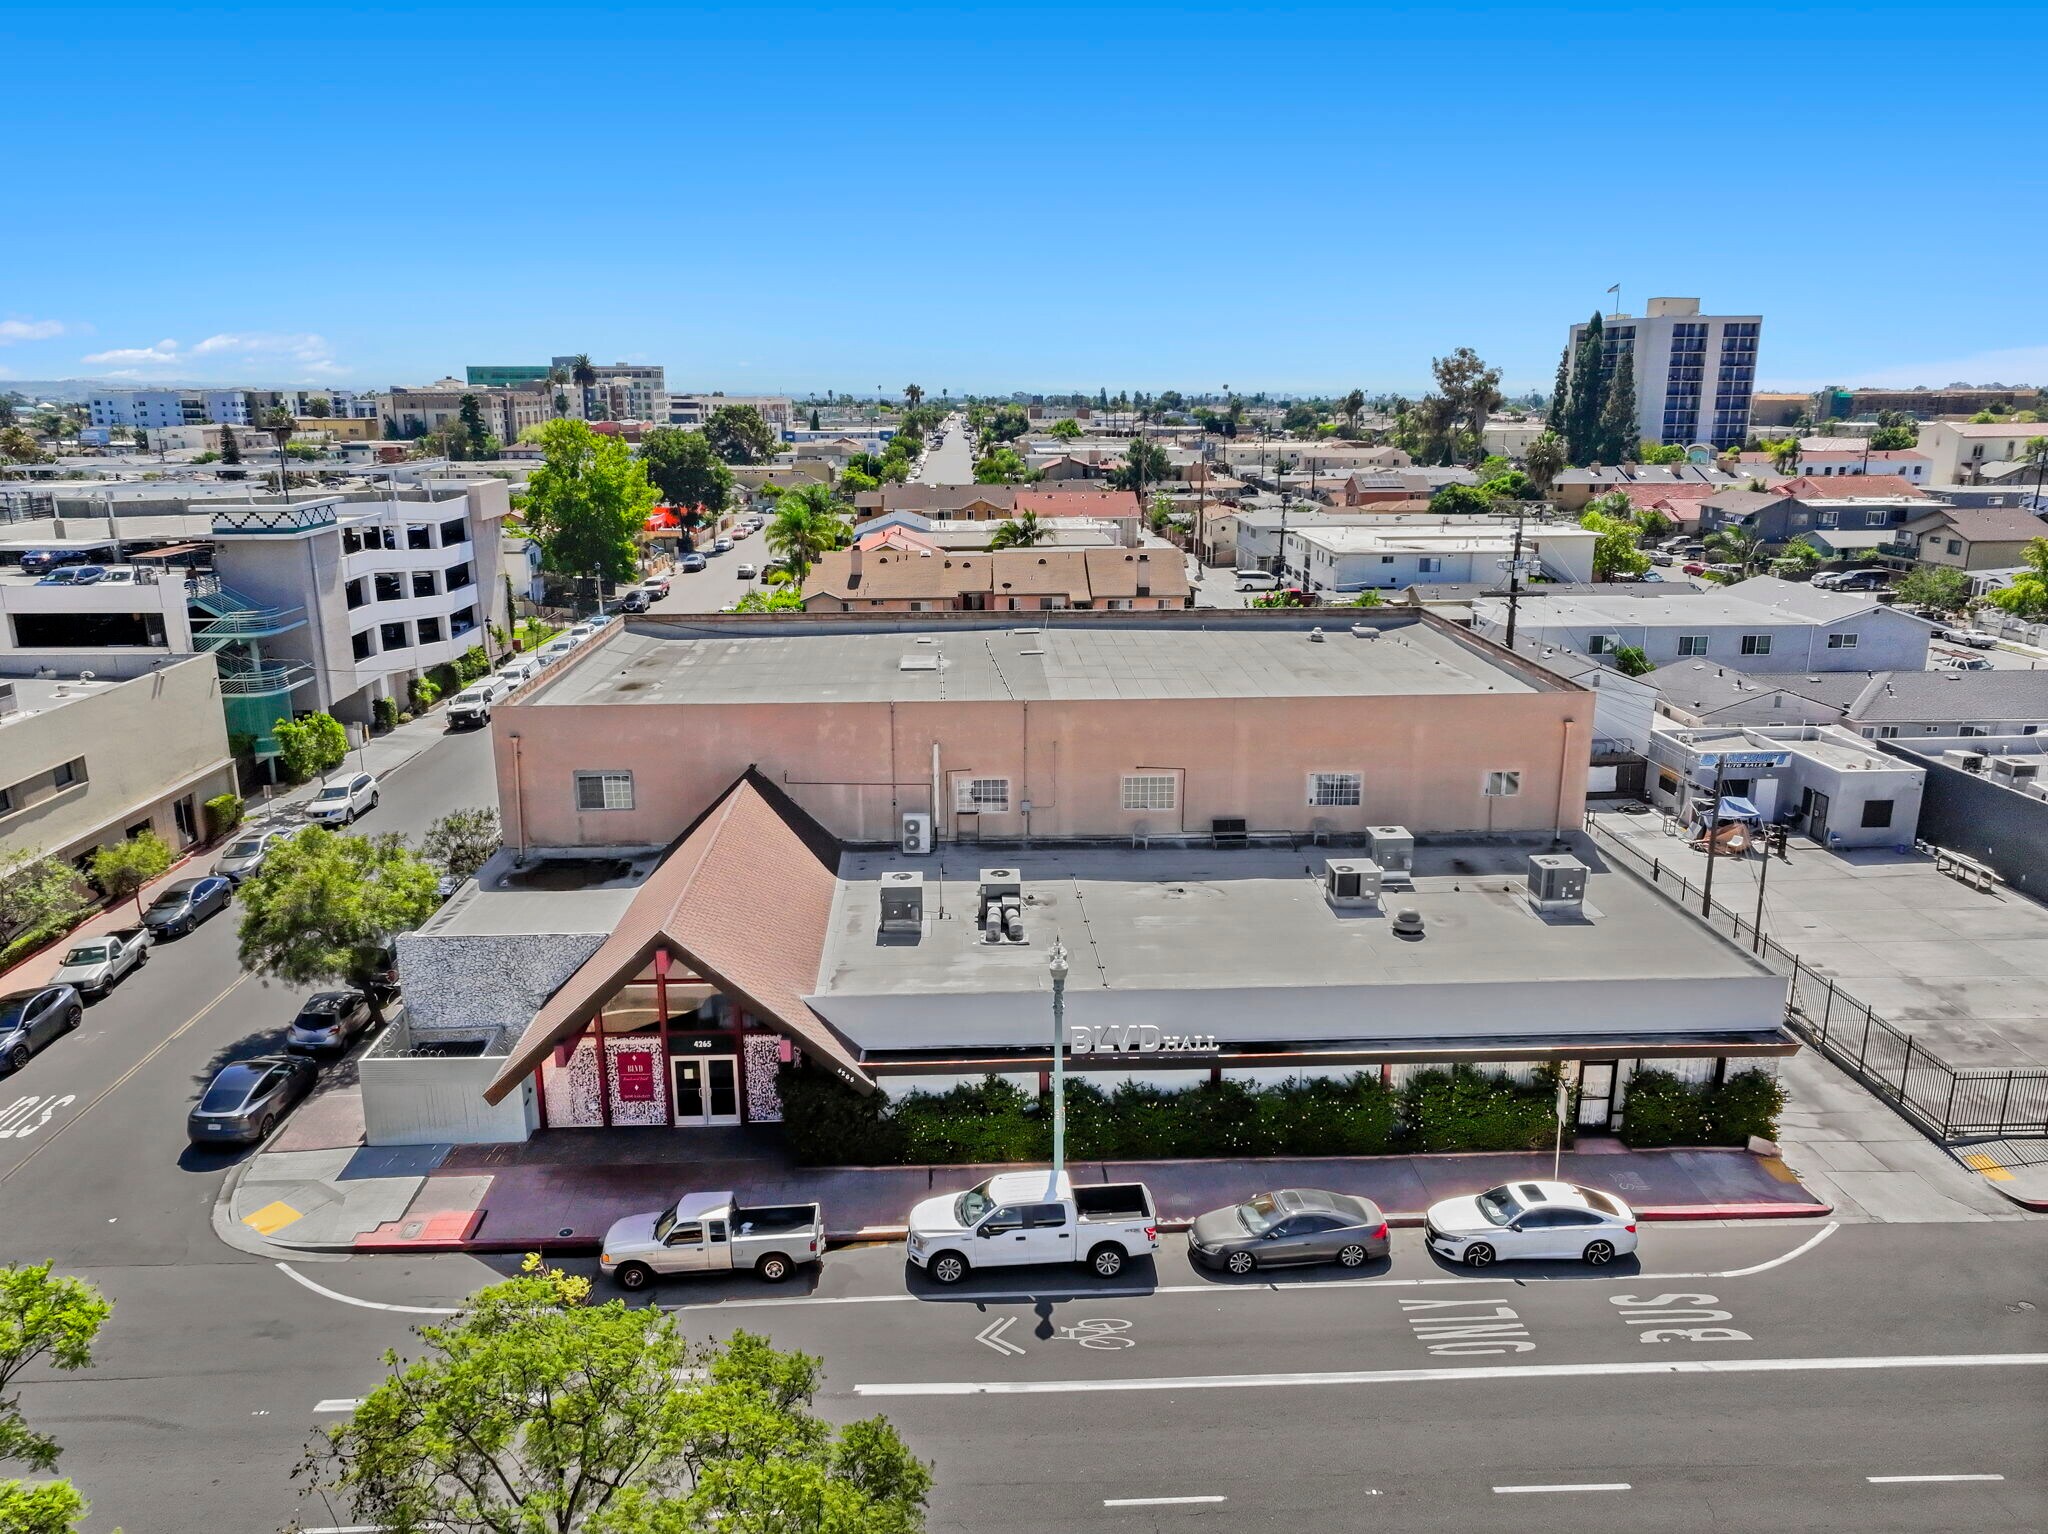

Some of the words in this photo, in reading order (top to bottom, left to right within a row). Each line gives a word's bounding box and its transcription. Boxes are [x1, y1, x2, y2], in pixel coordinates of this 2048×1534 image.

[693, 1040, 712, 1048] 4265
[1070, 1025, 1161, 1055] BLVD
[1162, 1035, 1220, 1051] HALL
[627, 1064, 644, 1073] BLVD
[1399, 1299, 1536, 1355] ONLY
[1609, 1293, 1753, 1344] BUS
